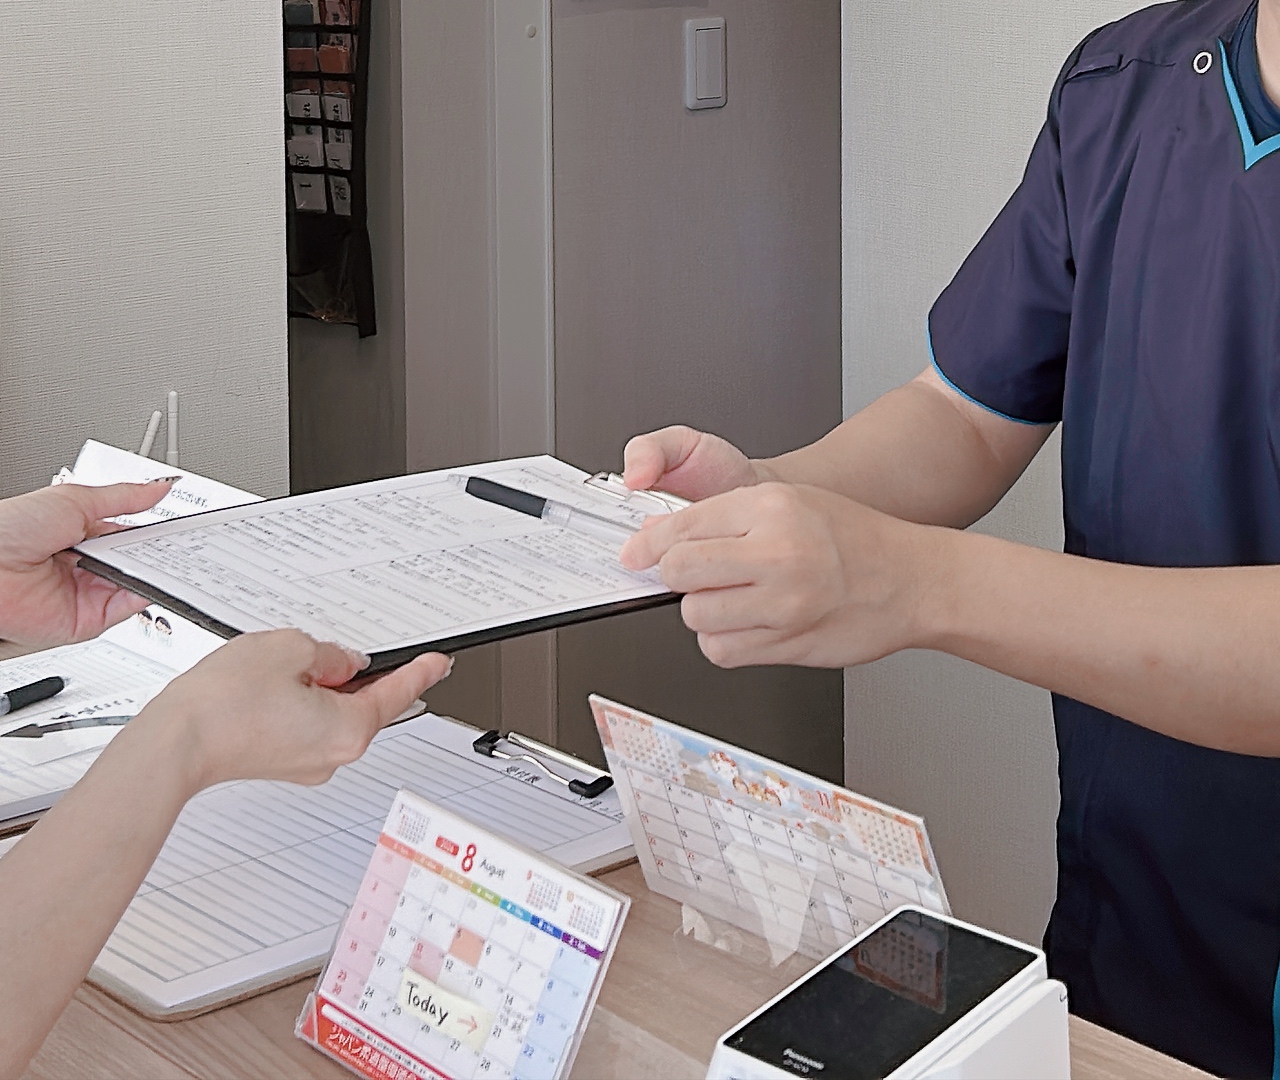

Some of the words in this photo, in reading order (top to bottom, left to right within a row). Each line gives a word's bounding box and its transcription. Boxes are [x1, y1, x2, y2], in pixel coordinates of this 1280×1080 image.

[460, 841, 478, 873] 8
[479, 857, 506, 878] August
[407, 980, 449, 1026] Today
